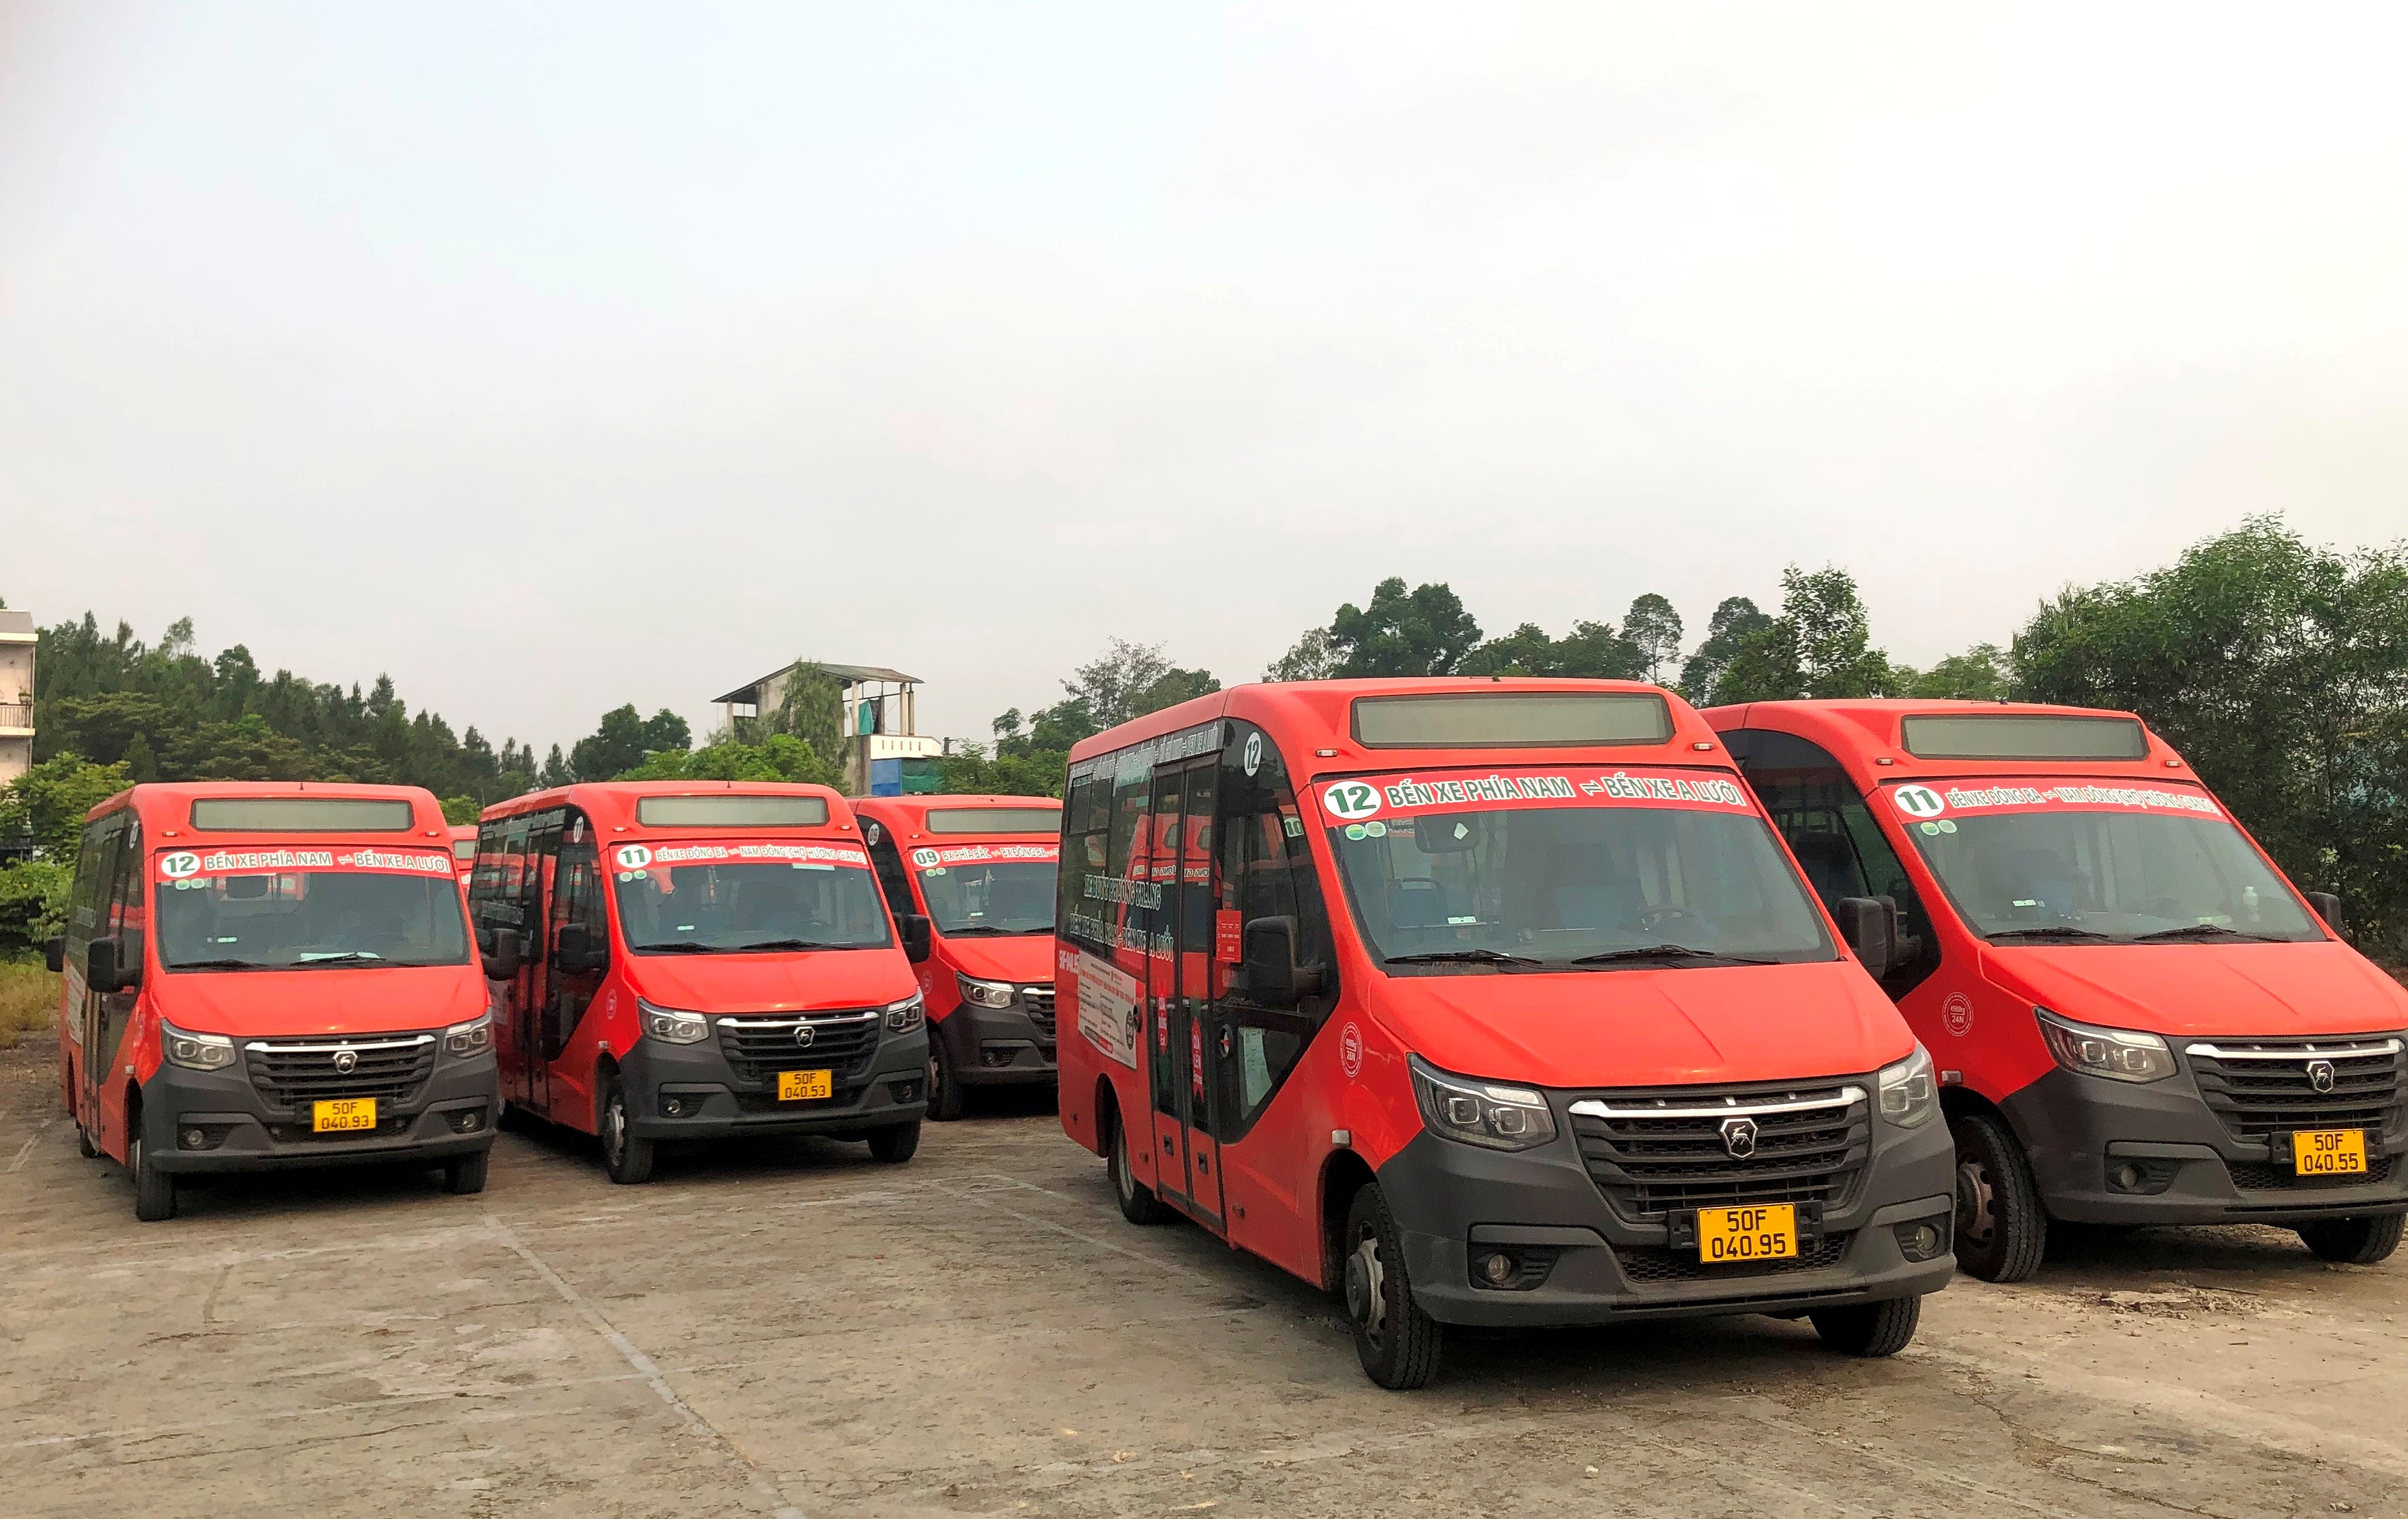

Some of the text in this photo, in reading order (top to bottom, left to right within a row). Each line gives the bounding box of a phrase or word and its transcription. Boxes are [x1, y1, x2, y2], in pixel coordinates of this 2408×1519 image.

[1247, 740, 1259, 770] 12
[1385, 772, 1747, 807] BẾN XE PHÍA NAM BẾN XE A LƯỚI
[1944, 787, 1974, 808] BẾN
[1970, 790, 1992, 806] XE
[1985, 786, 2027, 805] ĐÔNG
[2021, 788, 2046, 803] BA
[2054, 787, 2089, 803] NAM
[1328, 785, 1378, 813] 12
[1897, 789, 1939, 812] 11
[205, 851, 236, 870] BẾN
[237, 853, 258, 869] XE
[259, 850, 296, 867] PHÍA
[297, 851, 333, 866] NAM
[354, 850, 383, 866] BẾN
[384, 854, 404, 868] XE
[405, 855, 417, 870] A
[621, 849, 646, 864] 11
[655, 846, 674, 861] BẾN
[674, 849, 687, 861] XE
[687, 846, 714, 859] ĐÔNG
[714, 847, 729, 858] BA
[739, 846, 761, 857] NAM
[915, 851, 938, 864] 09
[941, 851, 955, 862] BX
[954, 848, 973, 861] PHÍA
[1000, 847, 1012, 858] BX
[1036, 848, 1049, 857] BA
[166, 855, 196, 873] 12
[794, 1073, 817, 1085] 50F
[785, 1085, 826, 1098] 040.53
[332, 1102, 358, 1115] 50F
[322, 1115, 369, 1130] 040.93
[2314, 1133, 2344, 1151] 50F
[2303, 1152, 2359, 1172] 040.55
[1727, 1209, 1767, 1232] 50F
[1712, 1233, 1786, 1258] 040.95
